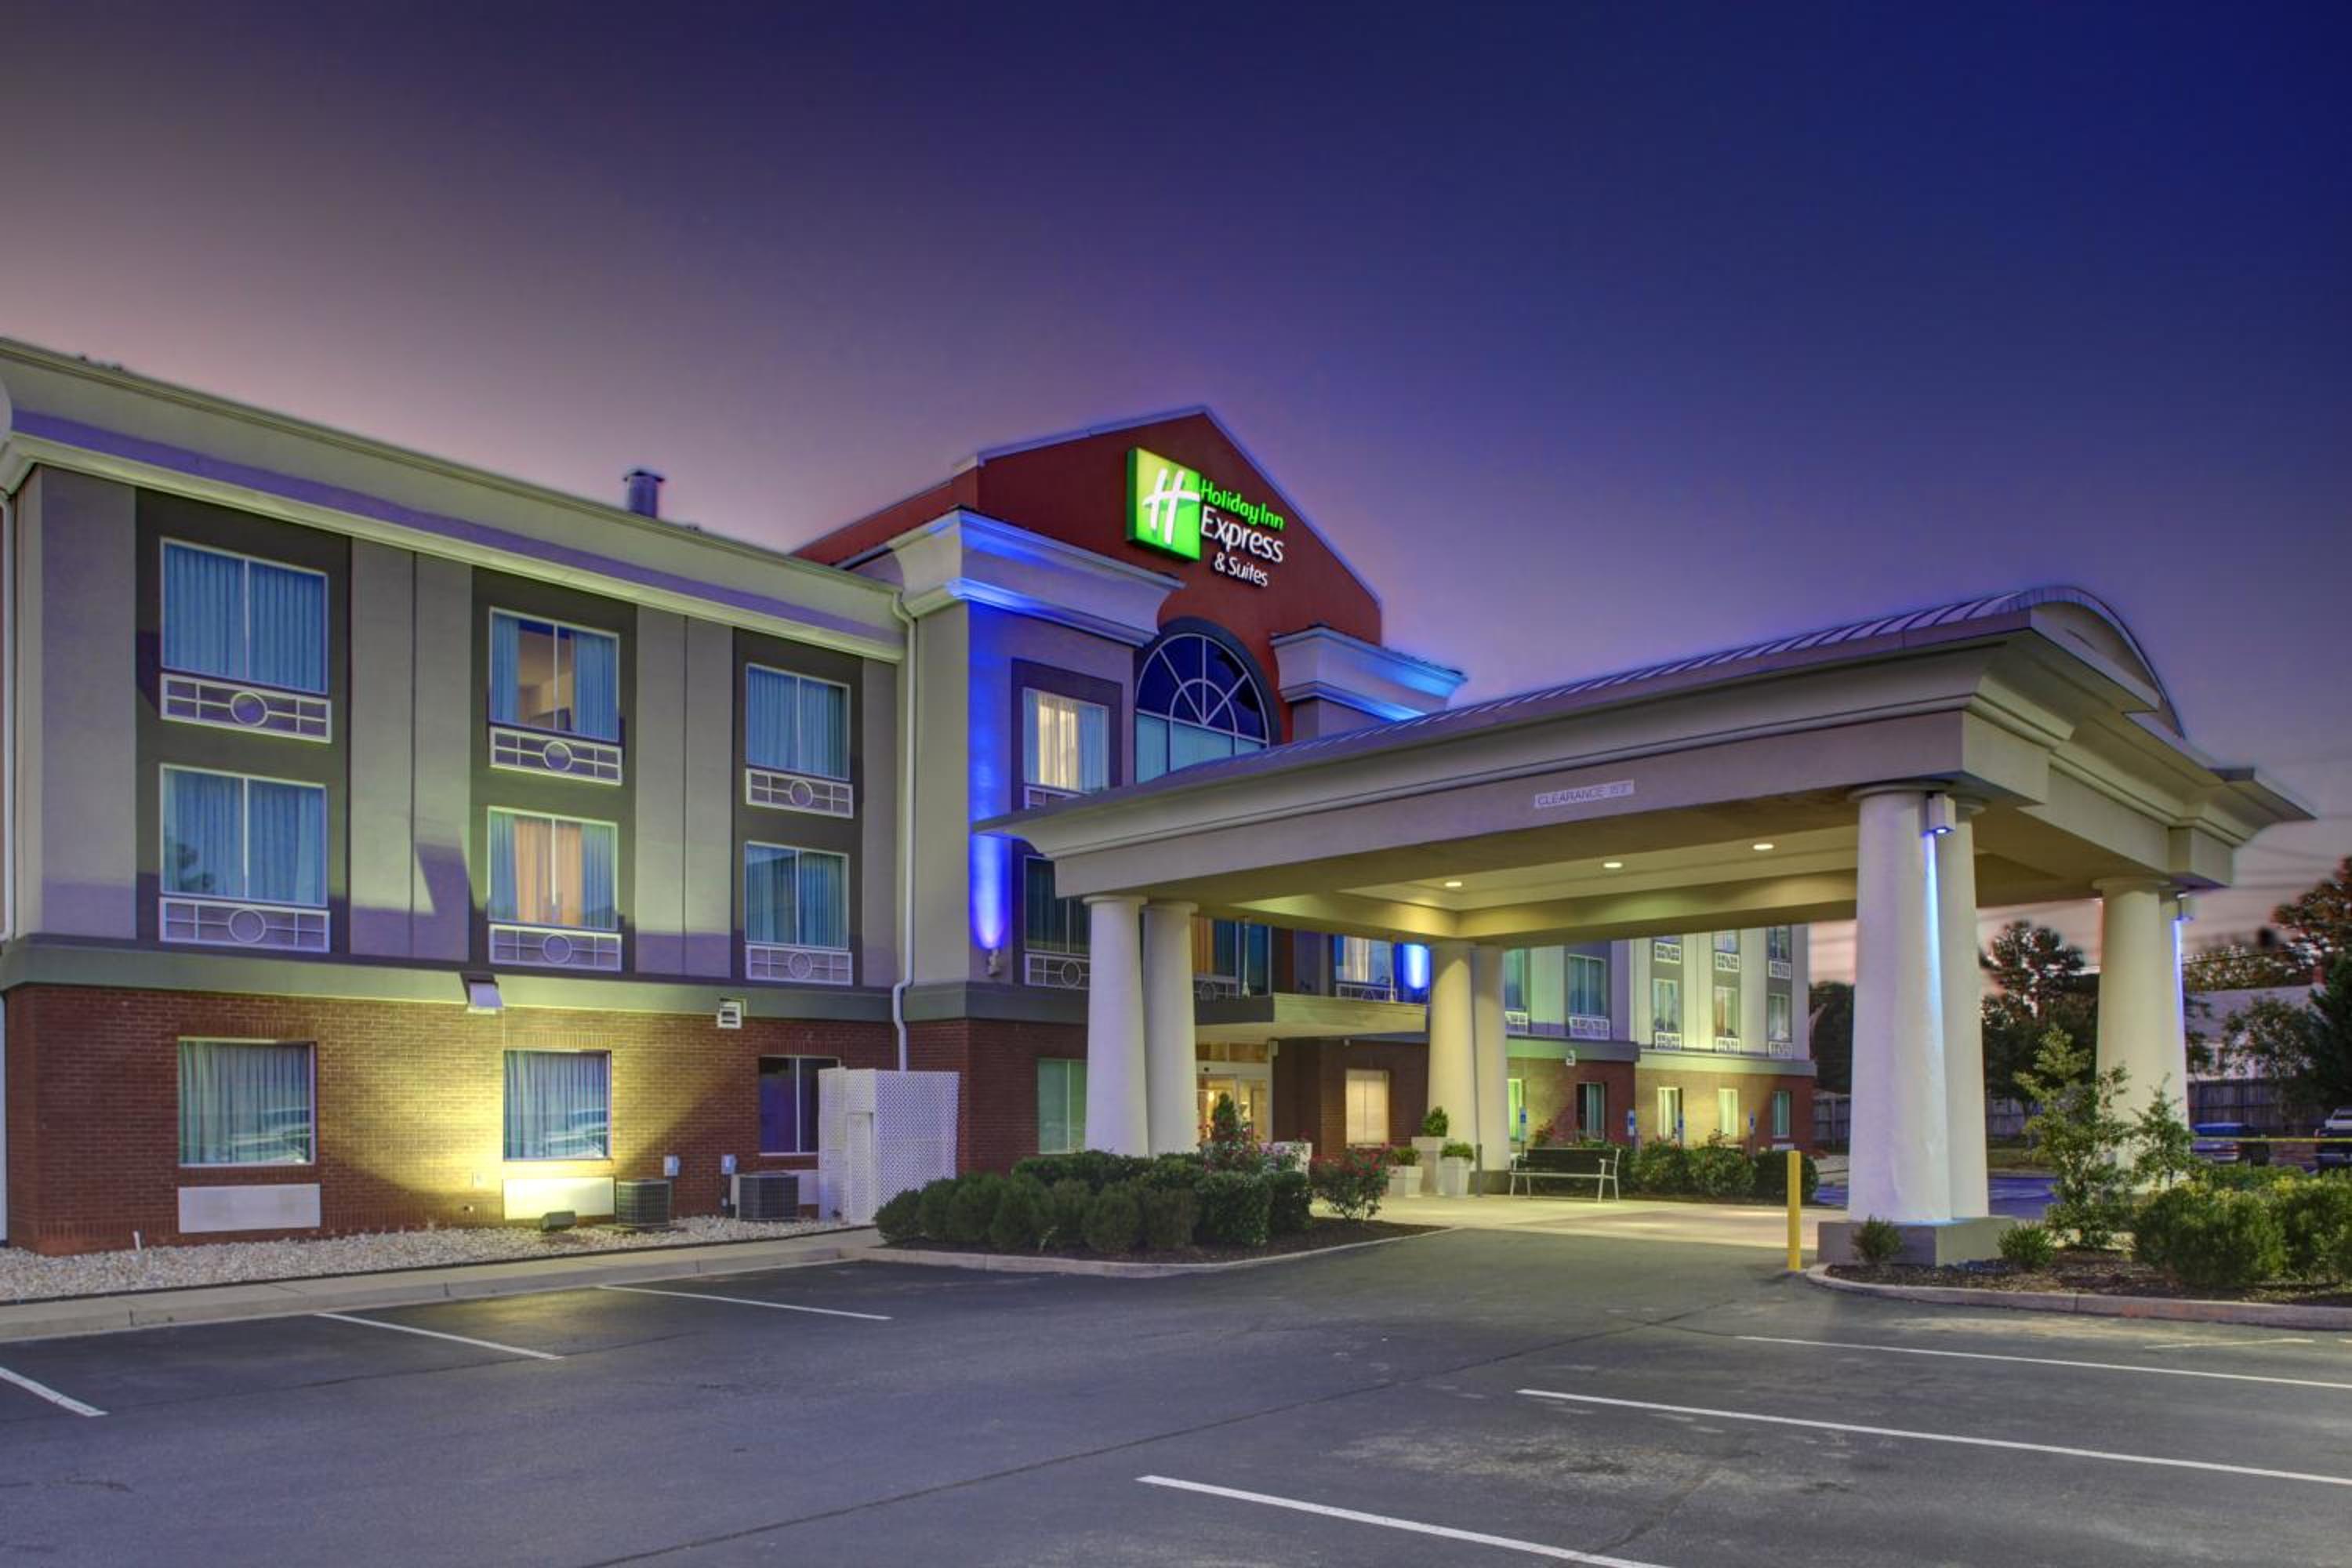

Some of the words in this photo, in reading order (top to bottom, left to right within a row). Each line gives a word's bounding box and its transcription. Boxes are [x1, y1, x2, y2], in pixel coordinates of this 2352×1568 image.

[1200, 506, 1285, 563] Express
[1214, 552, 1225, 572] &
[1228, 557, 1269, 587] Suites
